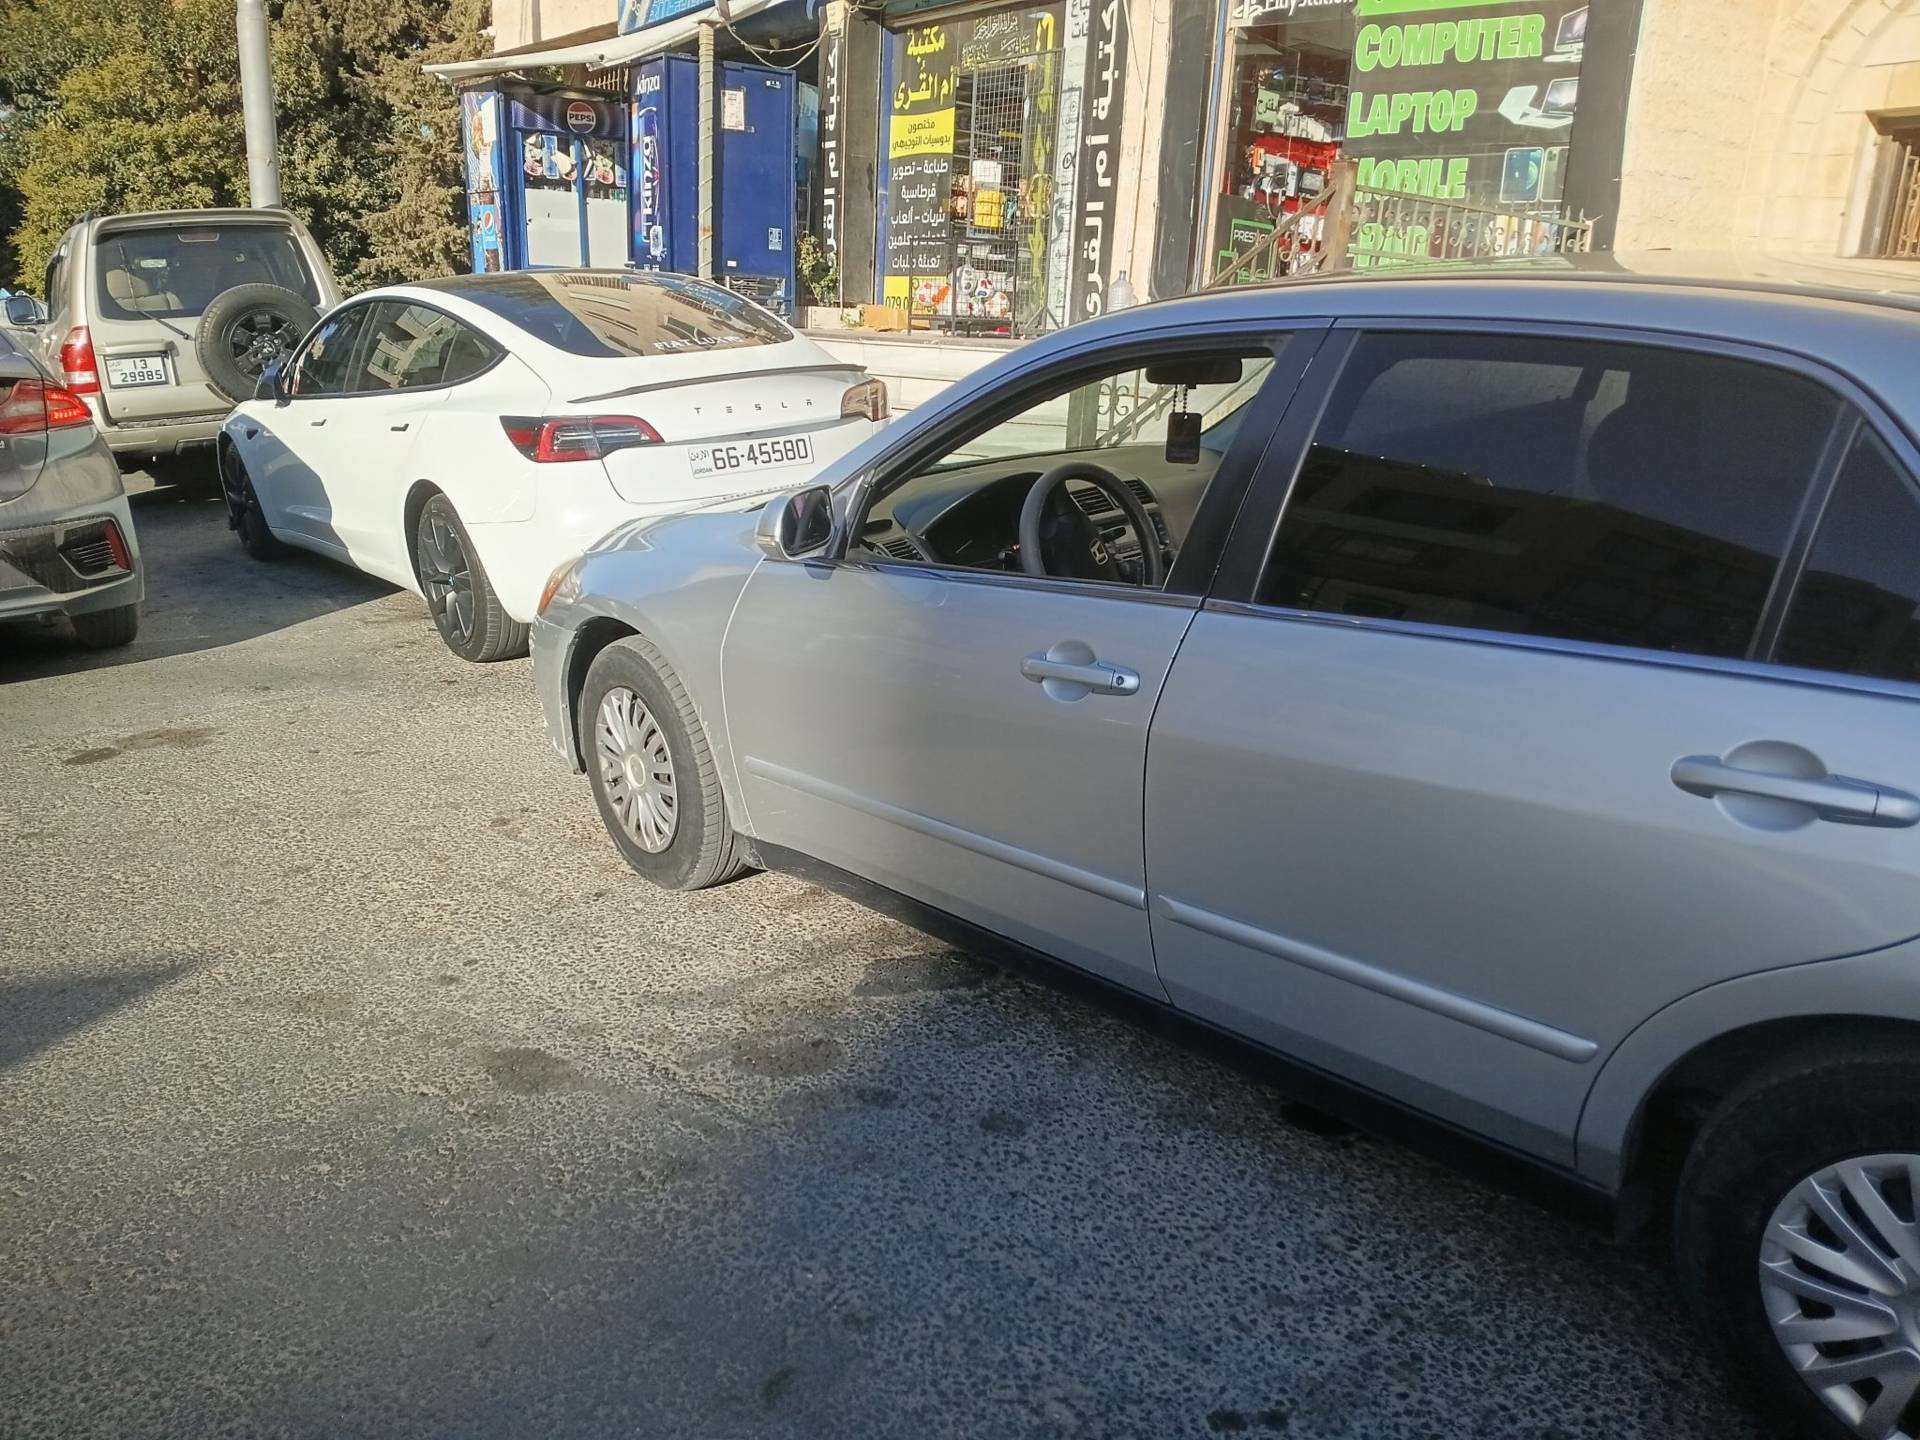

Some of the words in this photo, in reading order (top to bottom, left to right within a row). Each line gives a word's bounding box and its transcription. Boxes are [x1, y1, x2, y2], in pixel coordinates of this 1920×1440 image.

[907, 25, 945, 64] مكتبة
[1356, 13, 1545, 72] COMPUTER
[1093, 0, 1120, 120] كتبة
[636, 74, 661, 95] kinza
[826, 33, 840, 131] كتبة
[569, 113, 594, 122] PEPSI
[1346, 88, 1478, 138] LAPTOP
[892, 161, 916, 181] تصوير
[923, 158, 949, 177] طباعة
[901, 183, 937, 202] قرطاسية
[890, 205, 914, 229] ألعاب
[918, 253, 941, 272] تعبئة
[132, 359, 148, 370] 13
[120, 369, 163, 383] 29985
[693, 398, 813, 415] TESLA
[694, 467, 713, 475] JORDAN
